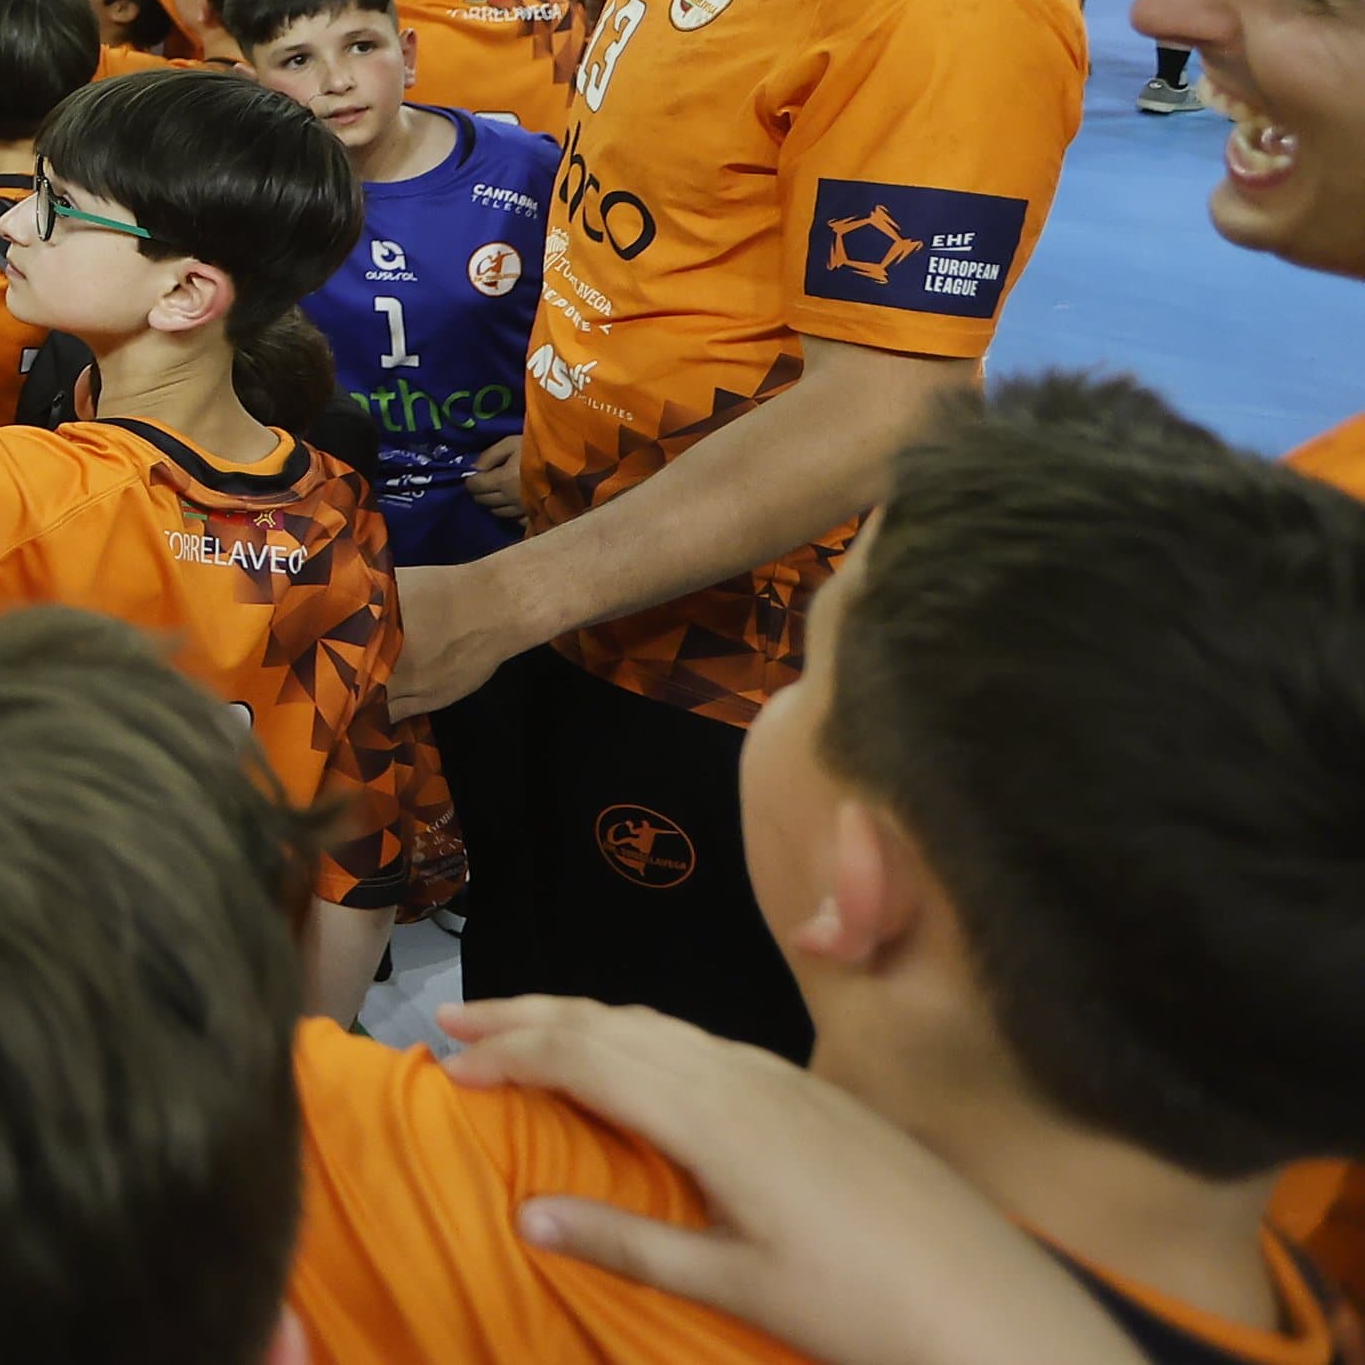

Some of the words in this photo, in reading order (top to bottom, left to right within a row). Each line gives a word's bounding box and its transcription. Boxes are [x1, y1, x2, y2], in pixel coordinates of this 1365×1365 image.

[931, 232, 976, 248] EHF
[928, 256, 1001, 281] EUROPEAN
[924, 274, 979, 297] LEAGUE
[373, 295, 420, 369] 1
